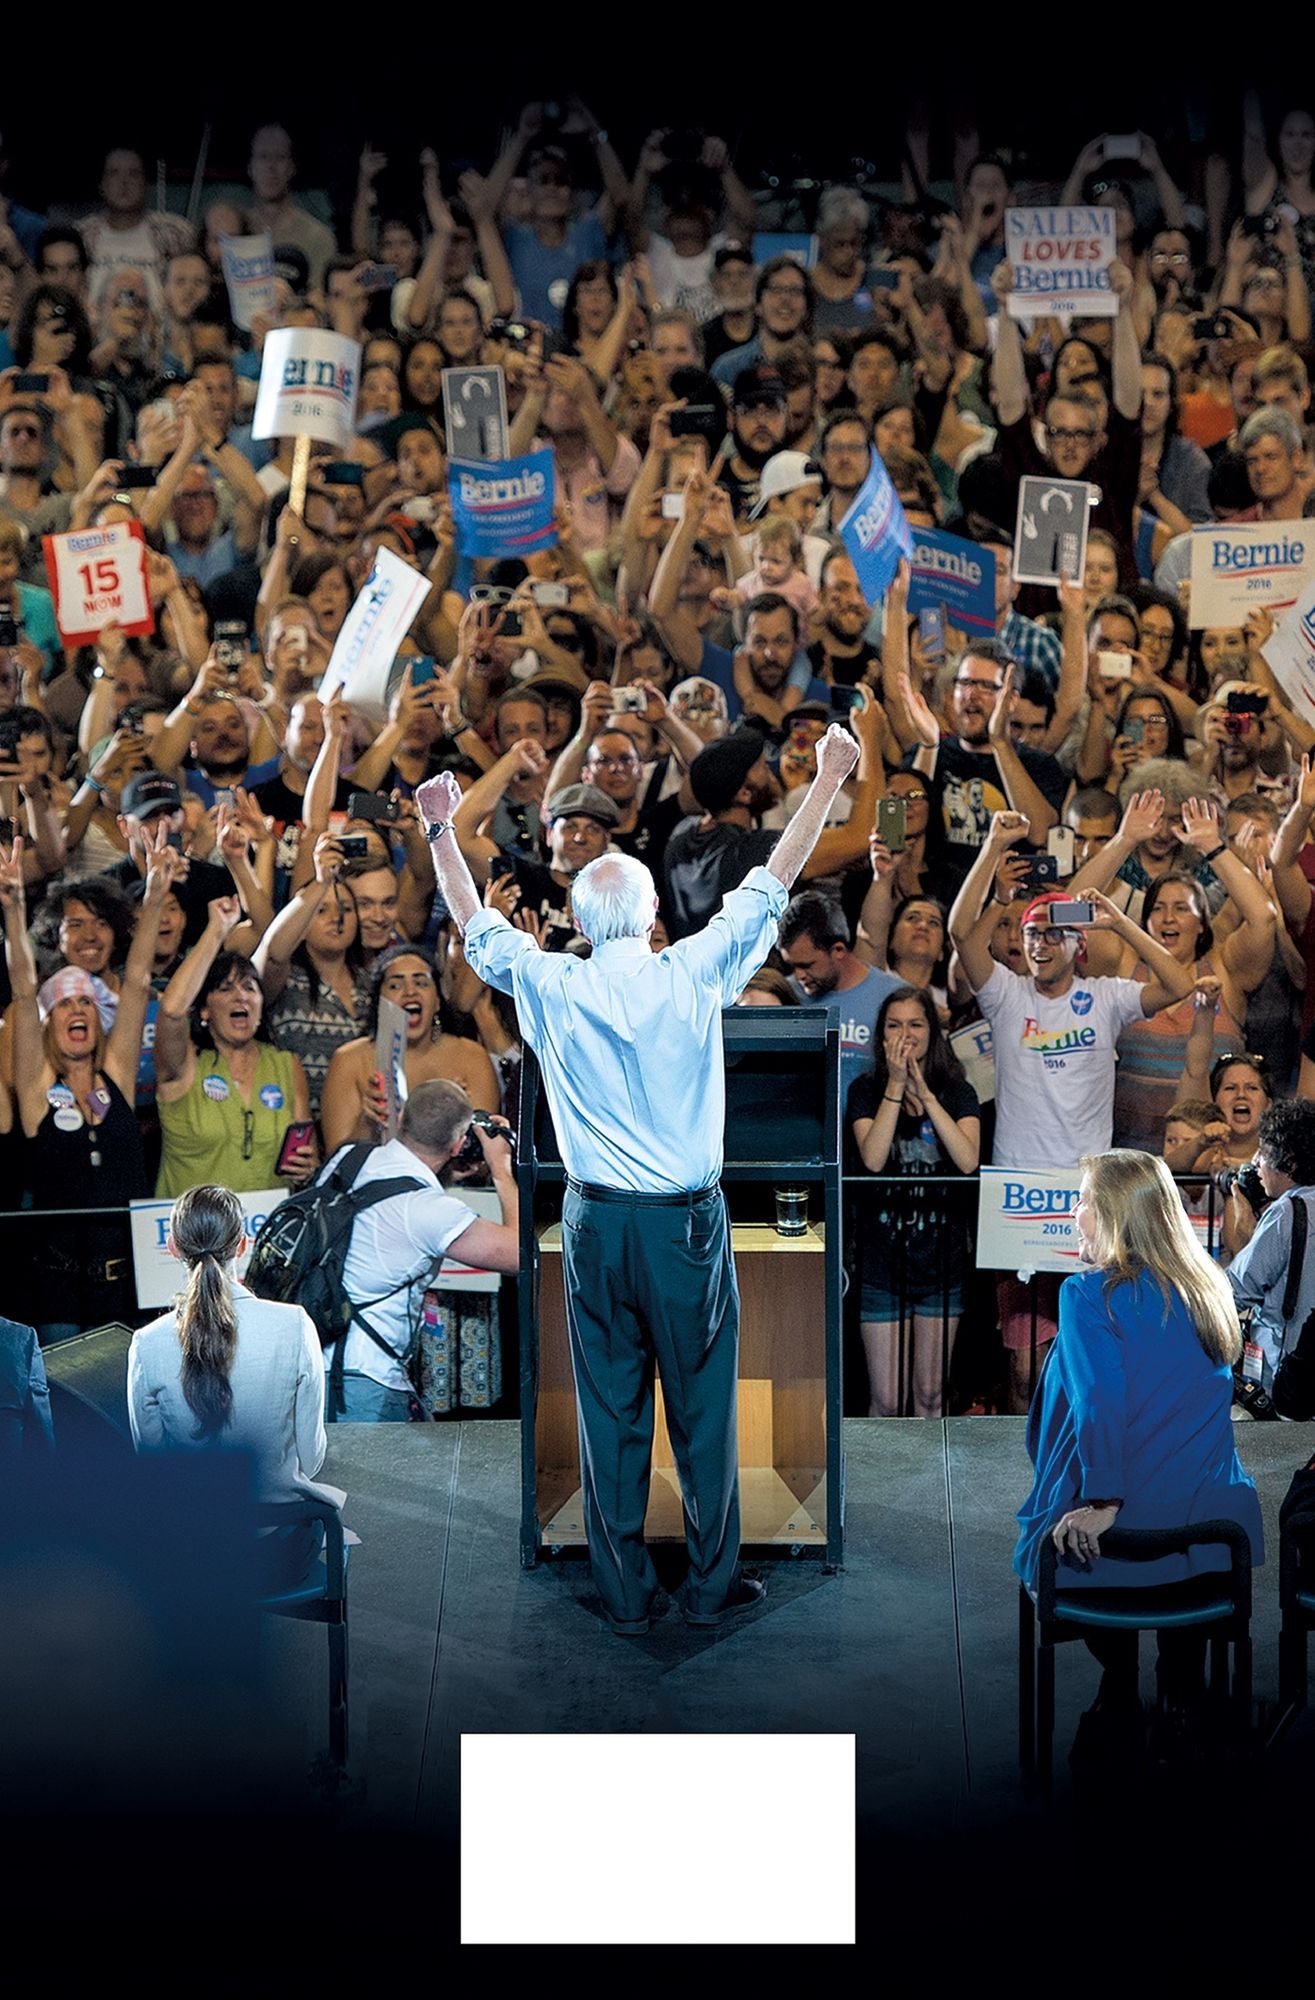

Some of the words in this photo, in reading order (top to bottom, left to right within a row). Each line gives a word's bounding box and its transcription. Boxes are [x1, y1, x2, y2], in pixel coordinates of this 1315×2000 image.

[1011, 210, 1111, 235] SALEM
[1023, 240, 1102, 261] LOVES
[1015, 263, 1109, 291] Bernie
[283, 358, 353, 396] ernie
[459, 468, 546, 505] Bernie
[67, 530, 118, 551] Bernie
[1212, 536, 1304, 570] Bernie
[79, 560, 119, 595] 15
[913, 545, 982, 585] ernie
[1246, 578, 1272, 591] 2016
[1002, 1183, 1081, 1212] Bern
[1042, 1223, 1072, 1236] 2016
